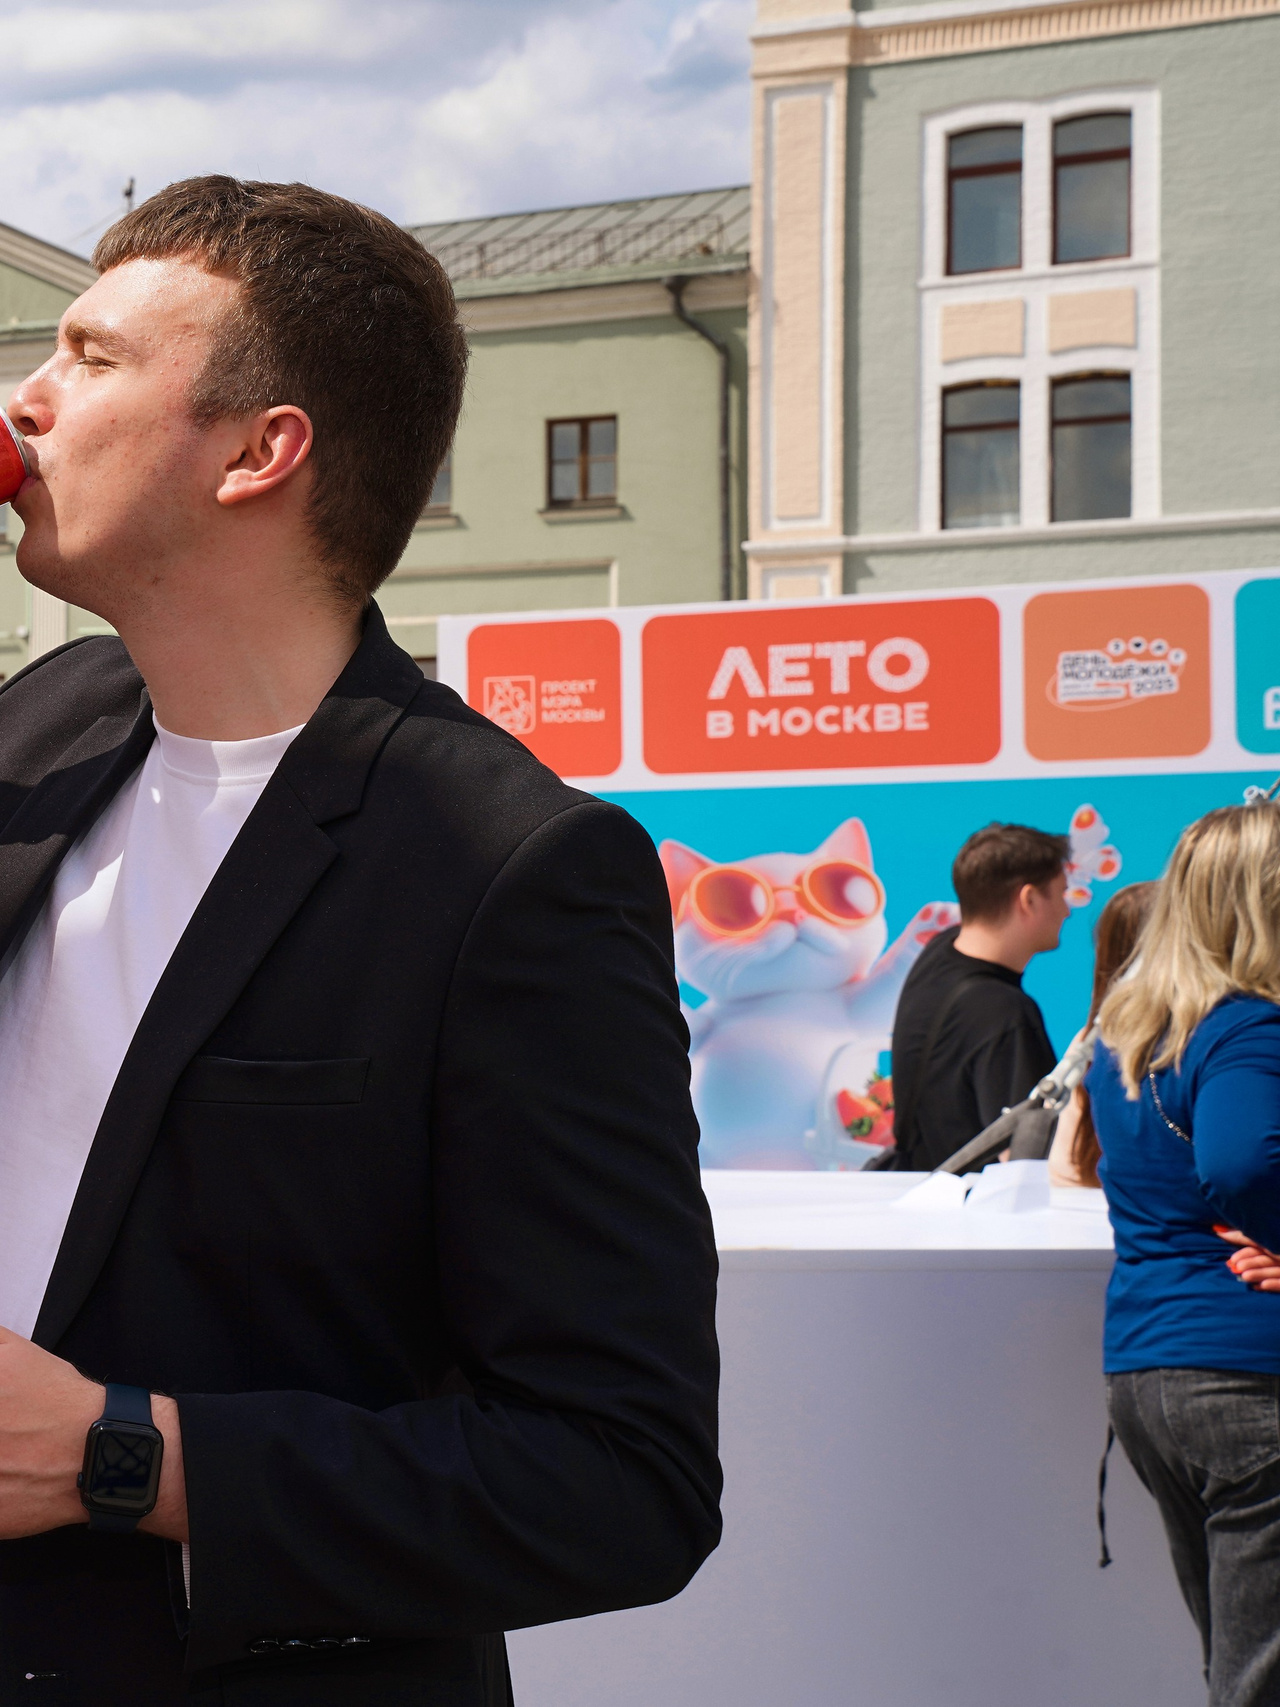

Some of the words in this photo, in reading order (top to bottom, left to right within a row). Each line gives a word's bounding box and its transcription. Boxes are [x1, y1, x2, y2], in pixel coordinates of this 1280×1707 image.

[707, 636, 930, 700] ЛЕТО
[540, 679, 597, 694] ПРОЕКТ
[541, 694, 582, 709] МЭРА
[541, 708, 605, 723] МОСКВЫ
[706, 710, 734, 739] В
[747, 701, 930, 737] МОСКВЕ
